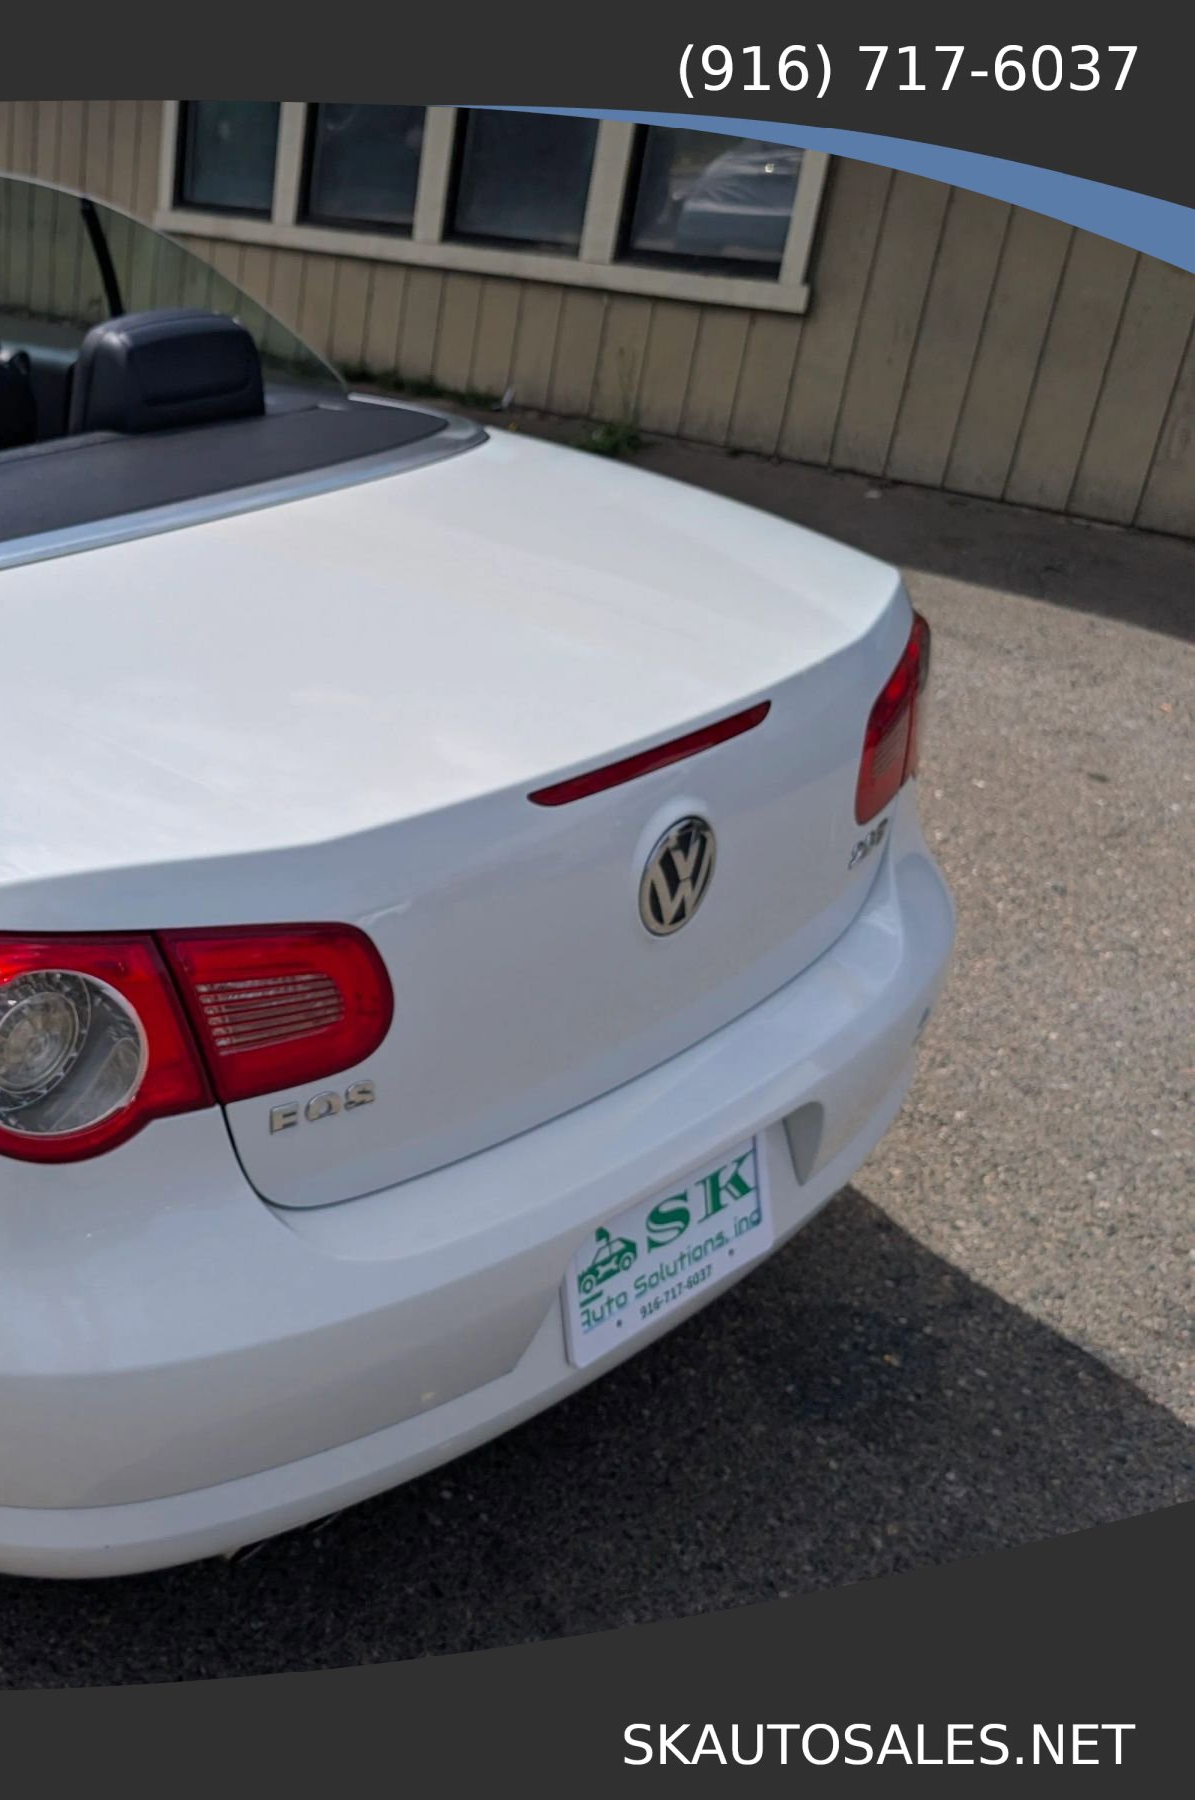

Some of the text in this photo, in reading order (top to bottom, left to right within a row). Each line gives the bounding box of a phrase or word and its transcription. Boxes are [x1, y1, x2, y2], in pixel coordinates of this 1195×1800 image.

[269, 1079, 376, 1134] EOS
[645, 1148, 757, 1254] SK
[580, 1291, 627, 1331] Auto
[639, 1264, 712, 1320] 916-717-6037
